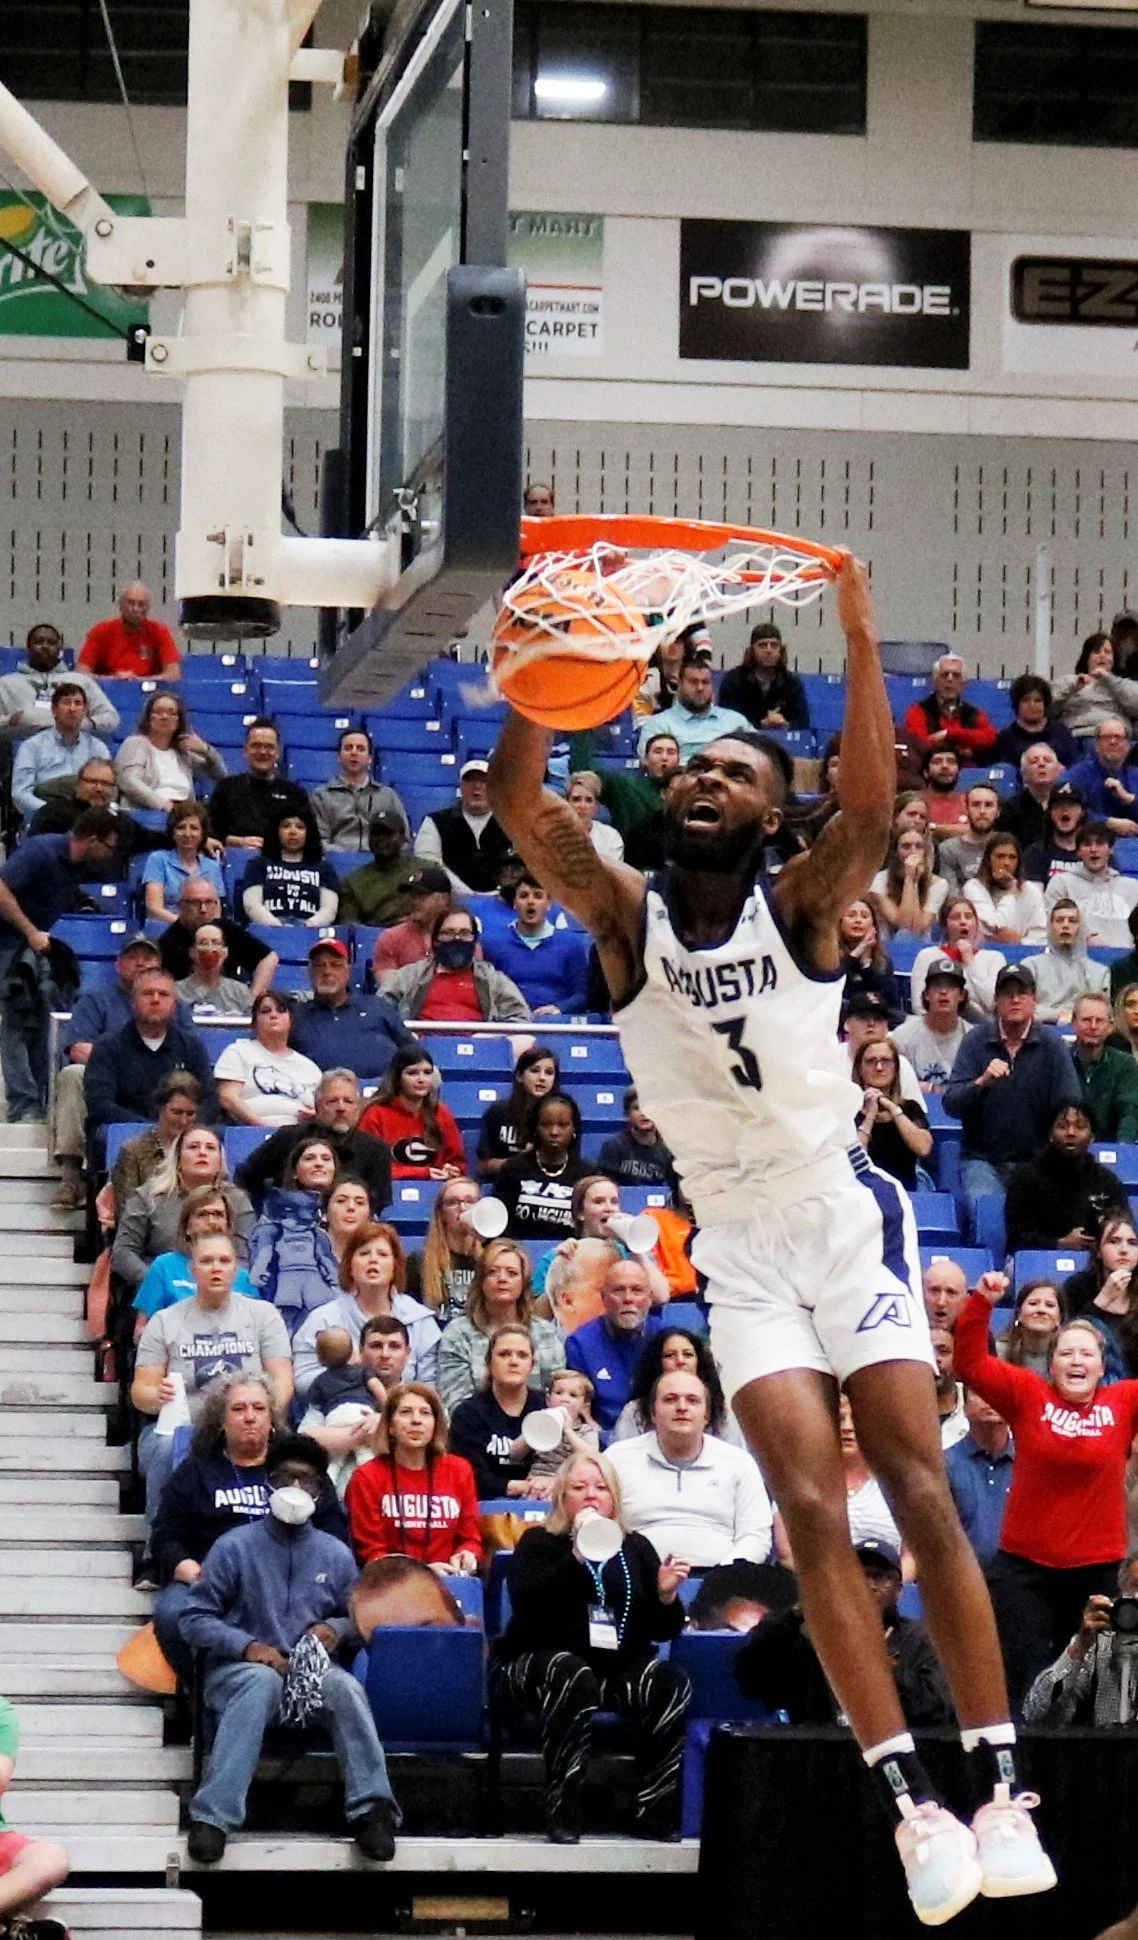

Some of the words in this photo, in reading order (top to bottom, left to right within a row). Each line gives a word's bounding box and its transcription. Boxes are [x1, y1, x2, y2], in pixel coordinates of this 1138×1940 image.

[526, 320, 598, 338] CARPET
[710, 1015, 763, 1091] 3
[180, 1341, 255, 1358] CHAMPIONS
[382, 1494, 460, 1519] AUGUSTA
